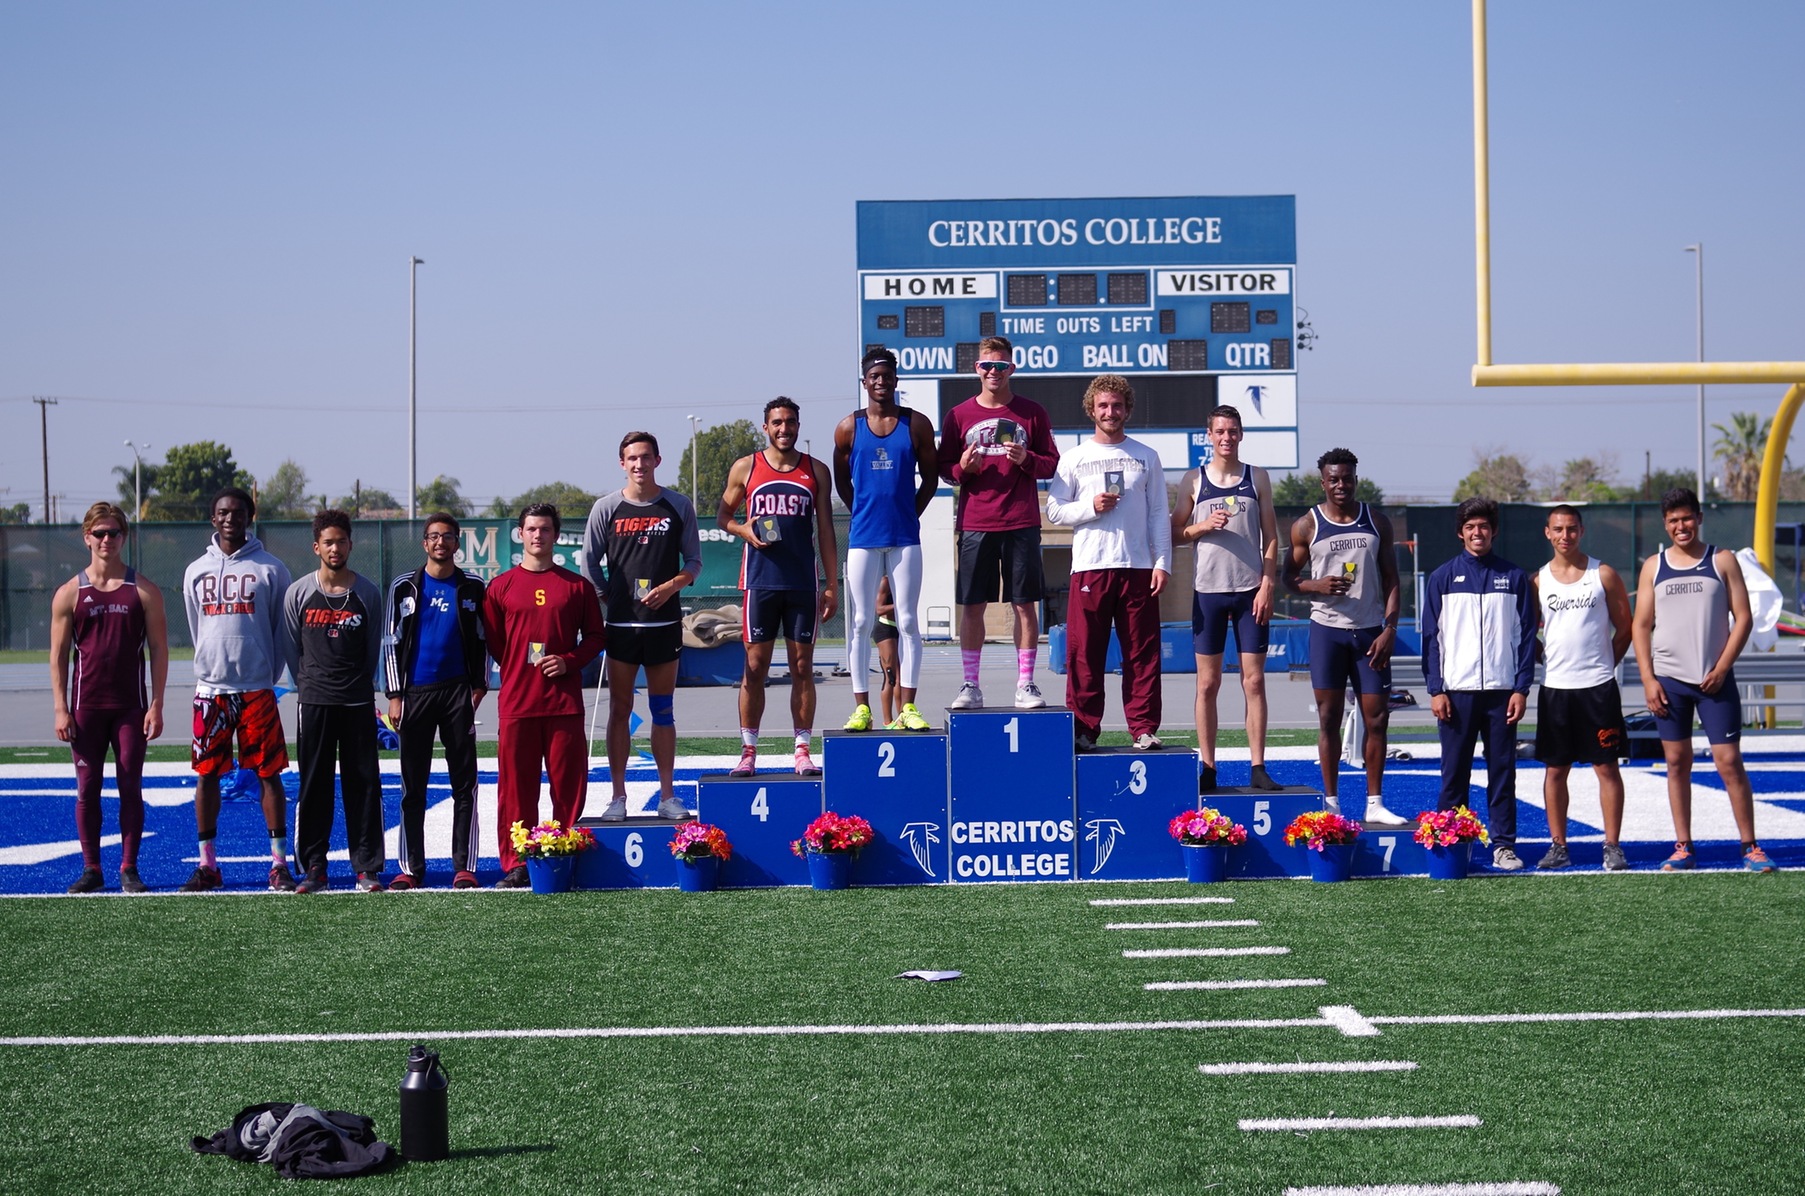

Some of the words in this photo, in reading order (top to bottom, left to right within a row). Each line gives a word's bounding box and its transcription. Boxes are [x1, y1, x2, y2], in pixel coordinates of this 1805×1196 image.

[928, 219, 1078, 247] CERRITOS
[1084, 217, 1222, 245] COLLEGE
[884, 277, 977, 296] HOME
[1170, 273, 1277, 292] VISITOR
[1002, 318, 1045, 334] TIME
[1056, 317, 1100, 334] OUTS
[1111, 316, 1153, 333] LEFT
[1083, 344, 1134, 368] BALL
[1137, 343, 1168, 367] ON
[1225, 342, 1270, 368] QTR
[755, 494, 810, 516] COAST
[615, 517, 671, 533] TIGERS
[1330, 538, 1367, 552] CERRITOS
[202, 573, 257, 603] RCC
[535, 589, 546, 606] S
[1666, 582, 1703, 596] CERRITOS
[108, 603, 129, 614] SAC
[1547, 590, 1597, 613] Riverside
[305, 608, 362, 627] TIGERS
[1003, 717, 1019, 752] 1
[877, 742, 896, 777] 2
[1129, 760, 1147, 795] 3
[750, 787, 769, 822] 4
[1253, 801, 1272, 836] 5
[951, 820, 1074, 844] CERRITOS
[624, 832, 643, 868] 6
[1378, 836, 1396, 872] 7
[956, 853, 1070, 877] COLLEGE
